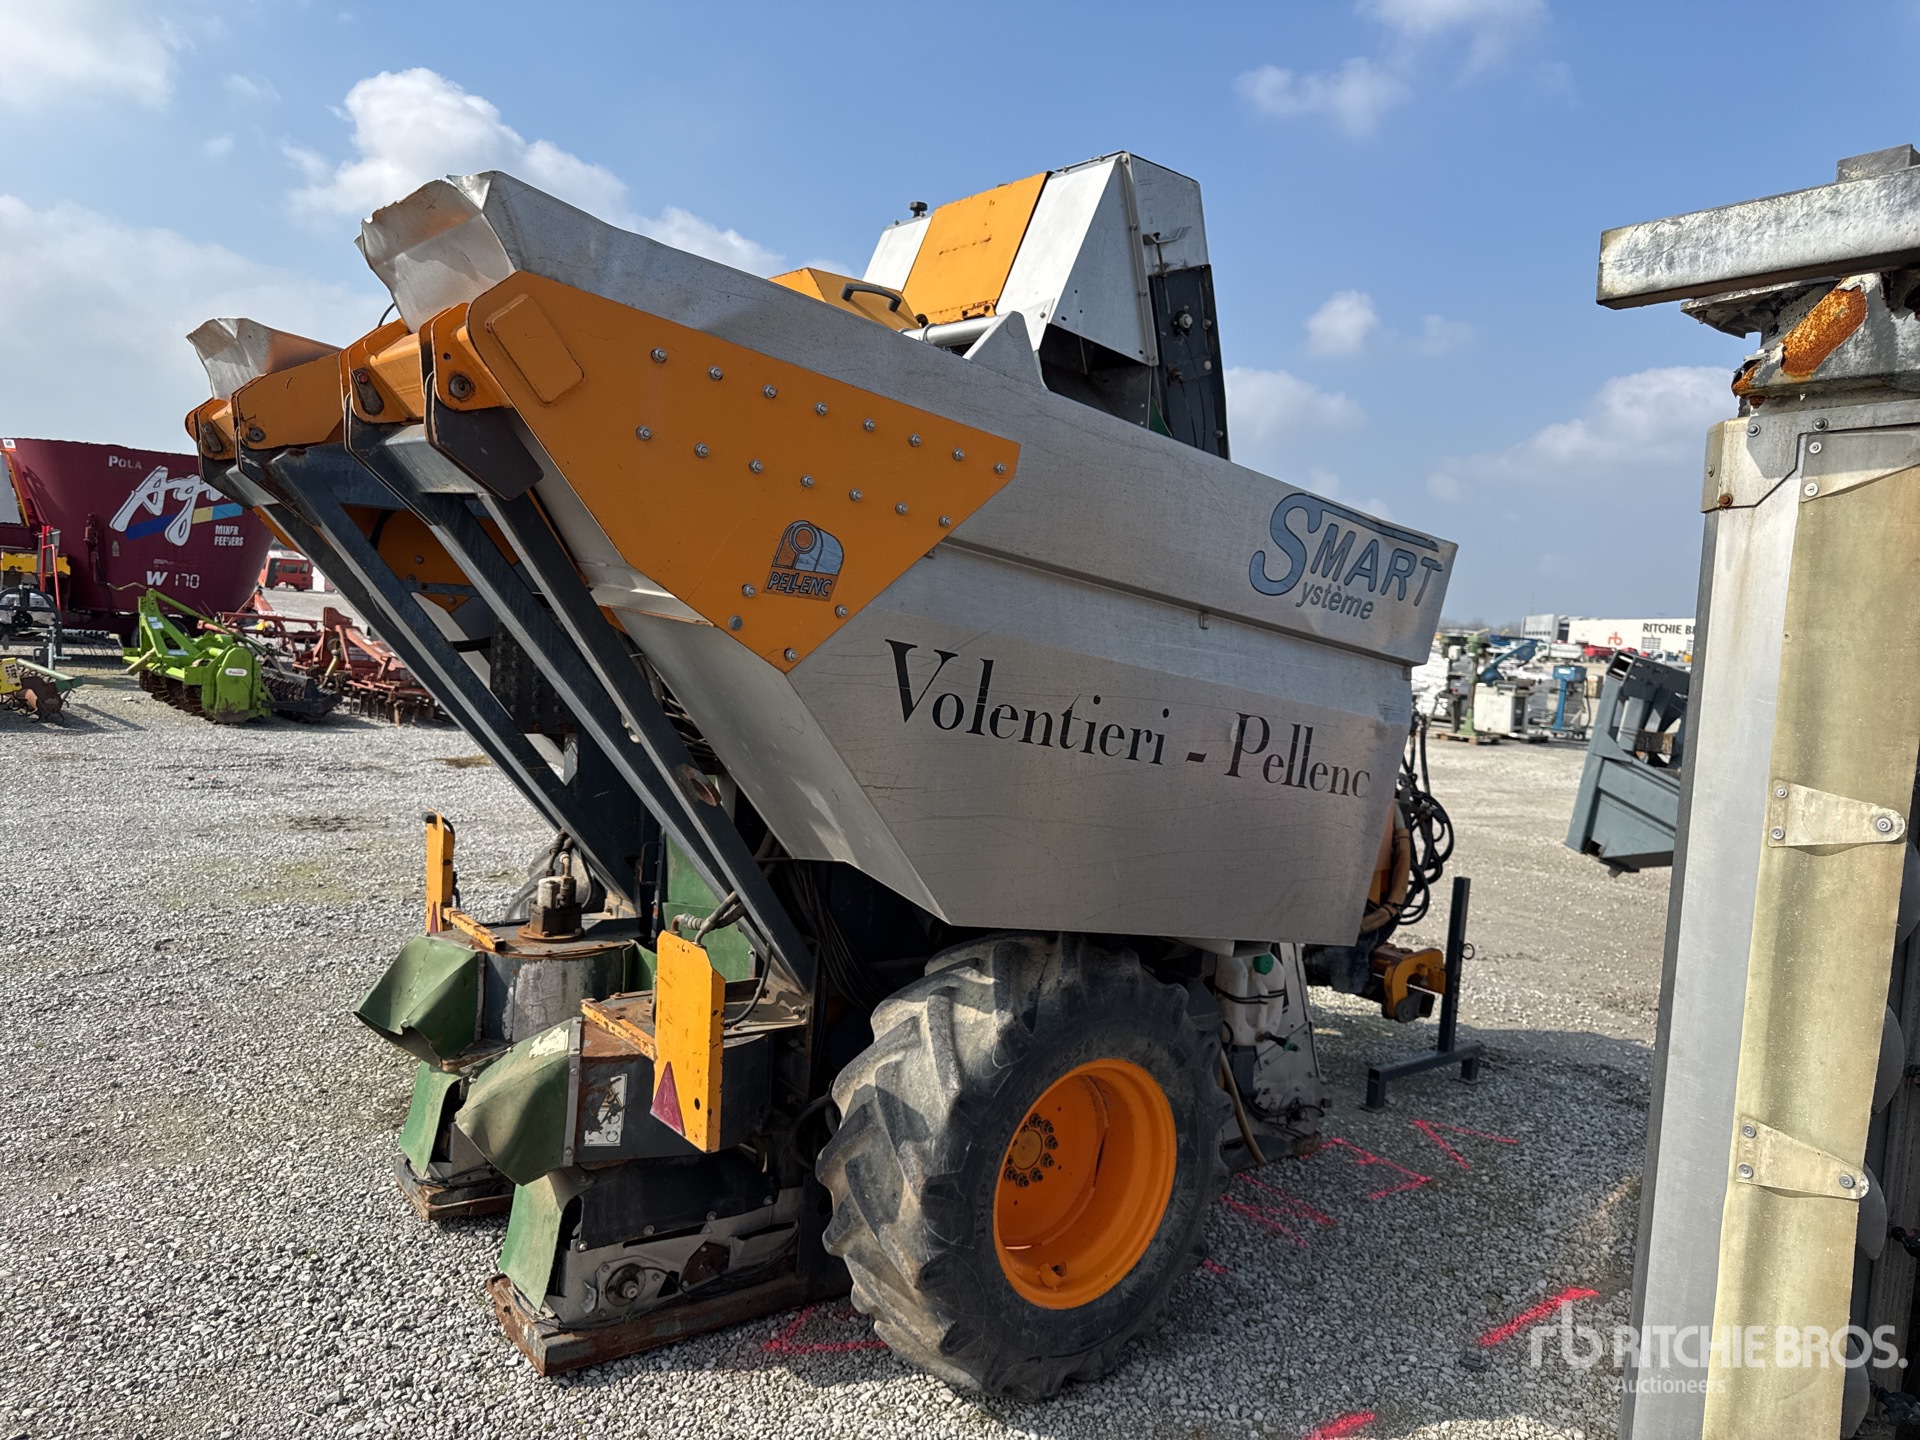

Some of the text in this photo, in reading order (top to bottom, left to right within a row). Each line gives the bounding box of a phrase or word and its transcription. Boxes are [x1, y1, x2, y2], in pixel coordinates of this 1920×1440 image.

[108, 455, 142, 470] POLA
[1249, 492, 1443, 606] SMART
[146, 571, 200, 589] W 170
[767, 571, 832, 596] PELLENC
[1642, 622, 1682, 635] RITCHIE
[885, 638, 1165, 766] Volentieri
[1224, 711, 1371, 798] Pellenc
